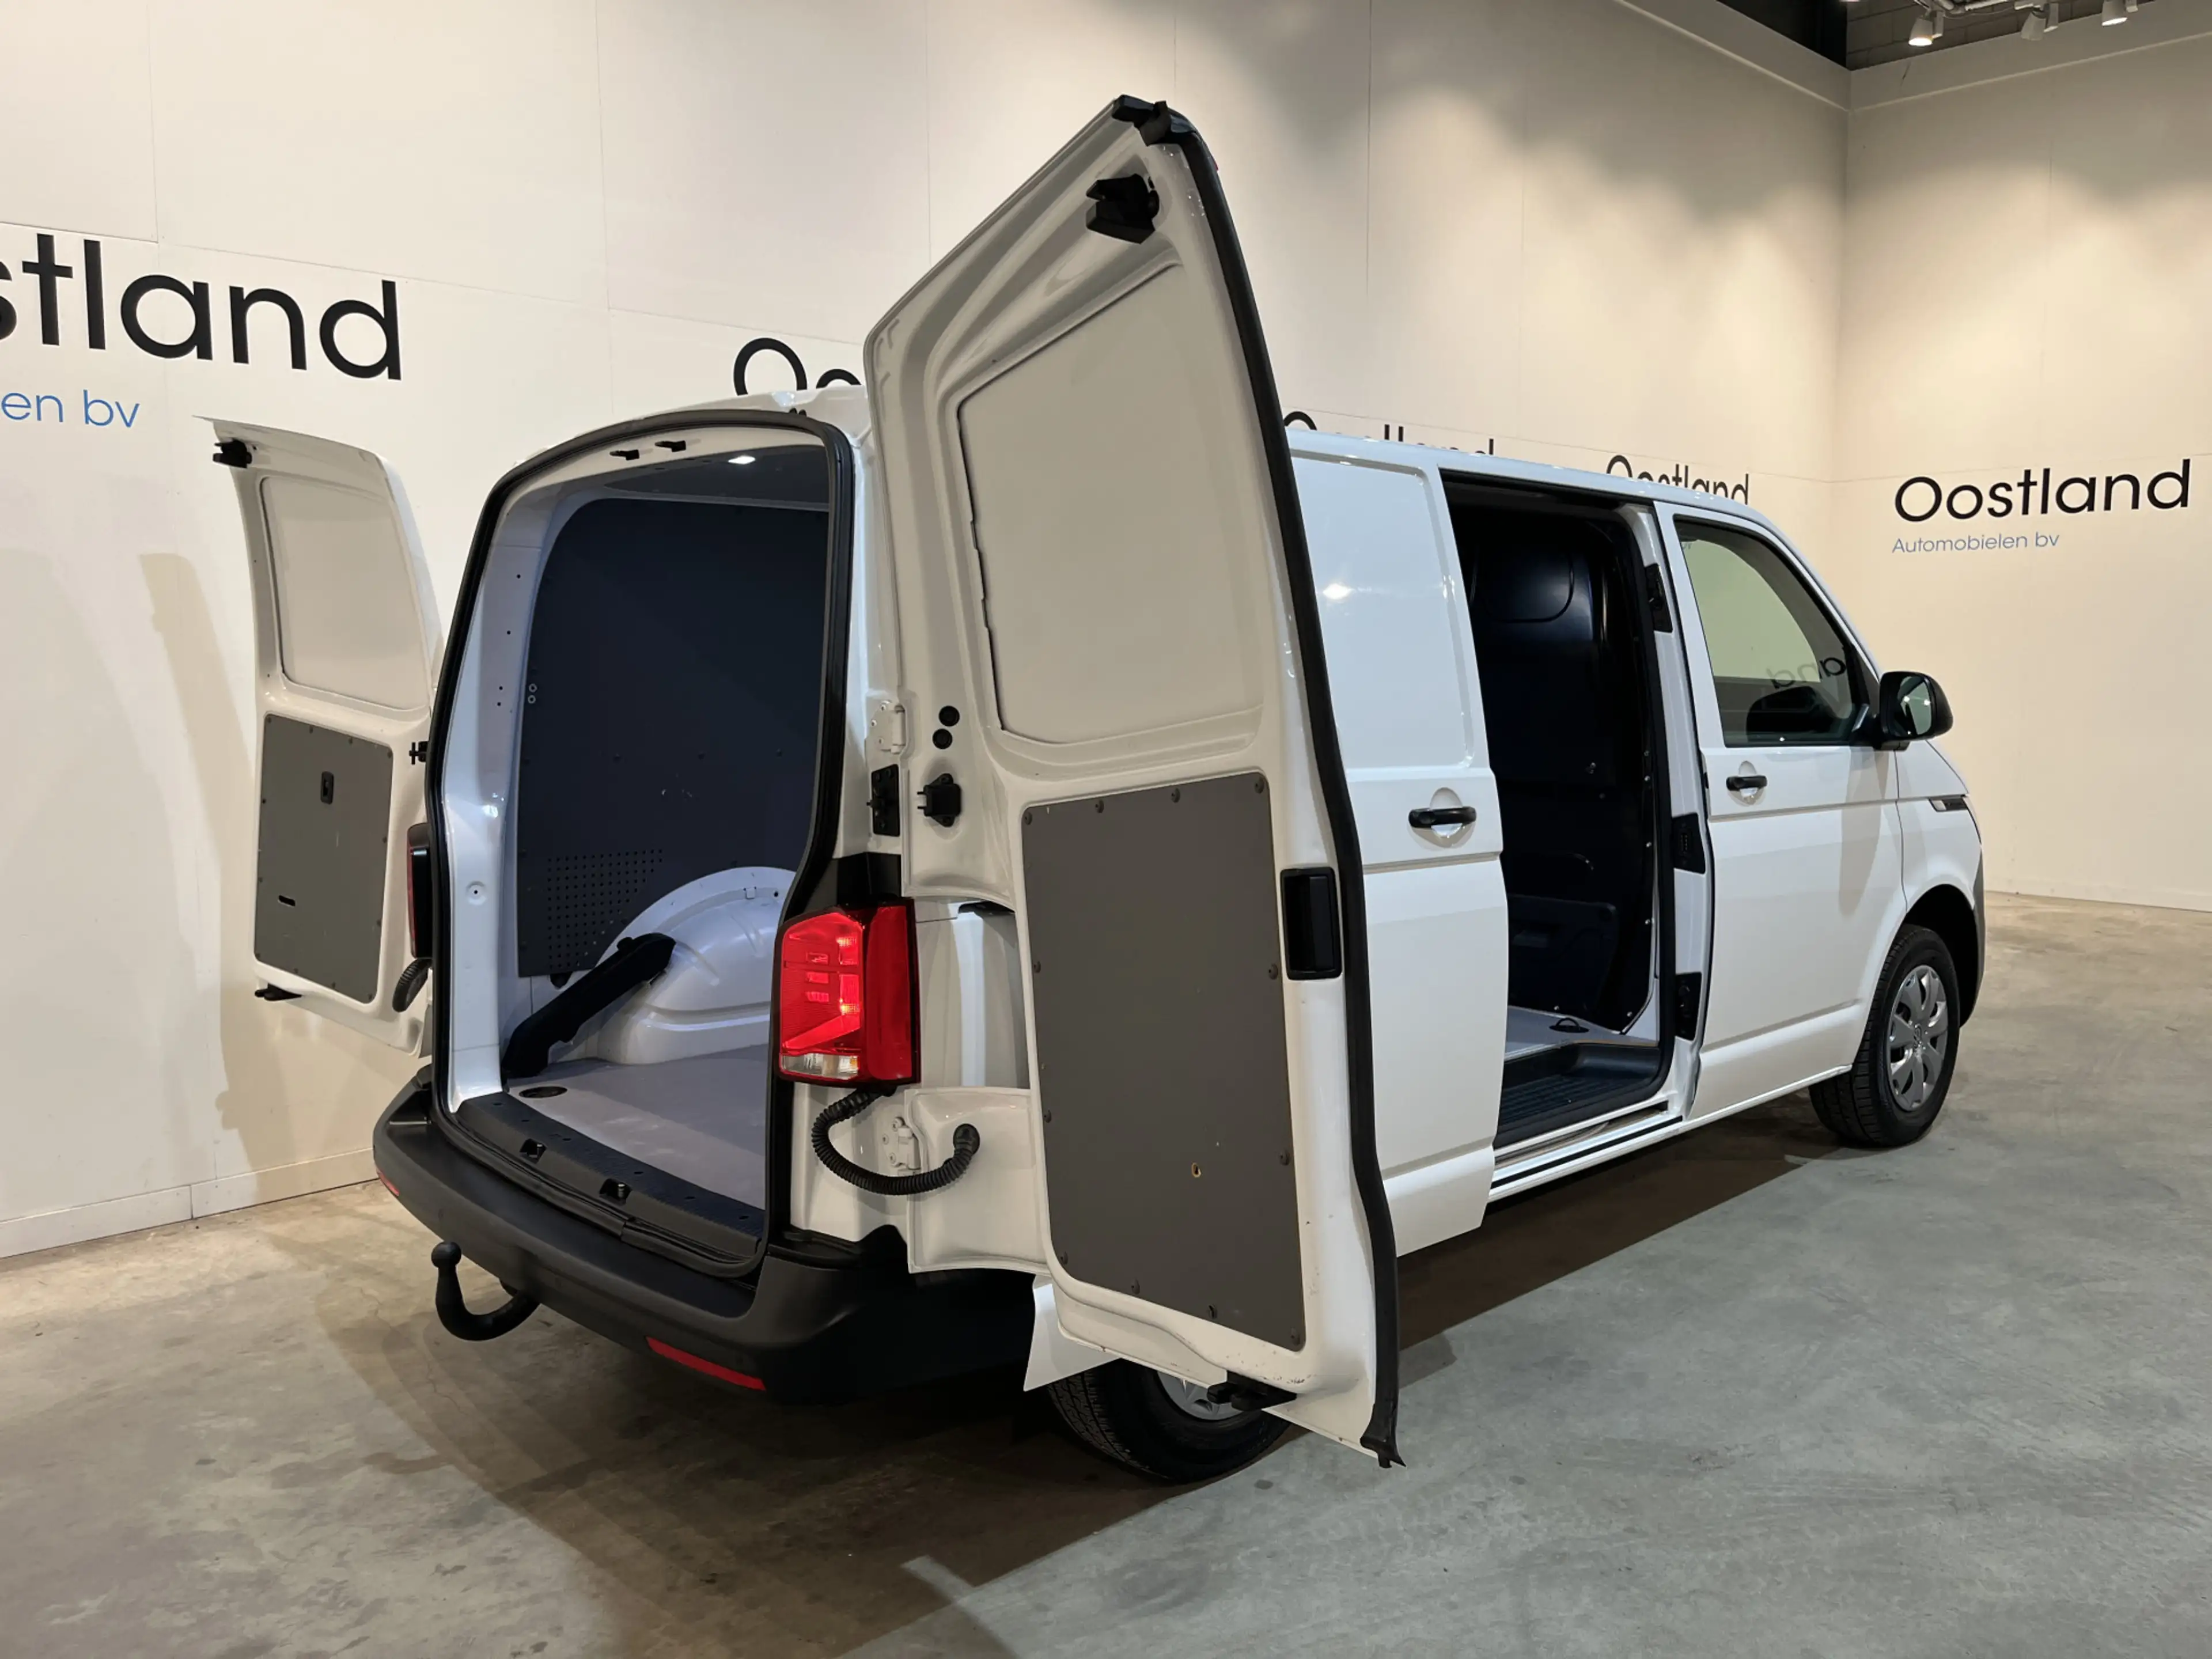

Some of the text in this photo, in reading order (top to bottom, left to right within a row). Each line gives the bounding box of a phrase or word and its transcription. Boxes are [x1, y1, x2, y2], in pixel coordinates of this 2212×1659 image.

[82, 389, 140, 428] bv
[1606, 454, 1749, 505] tlnd
[1895, 458, 2191, 522] Oostland
[1892, 532, 2061, 554] Automobielen bv
